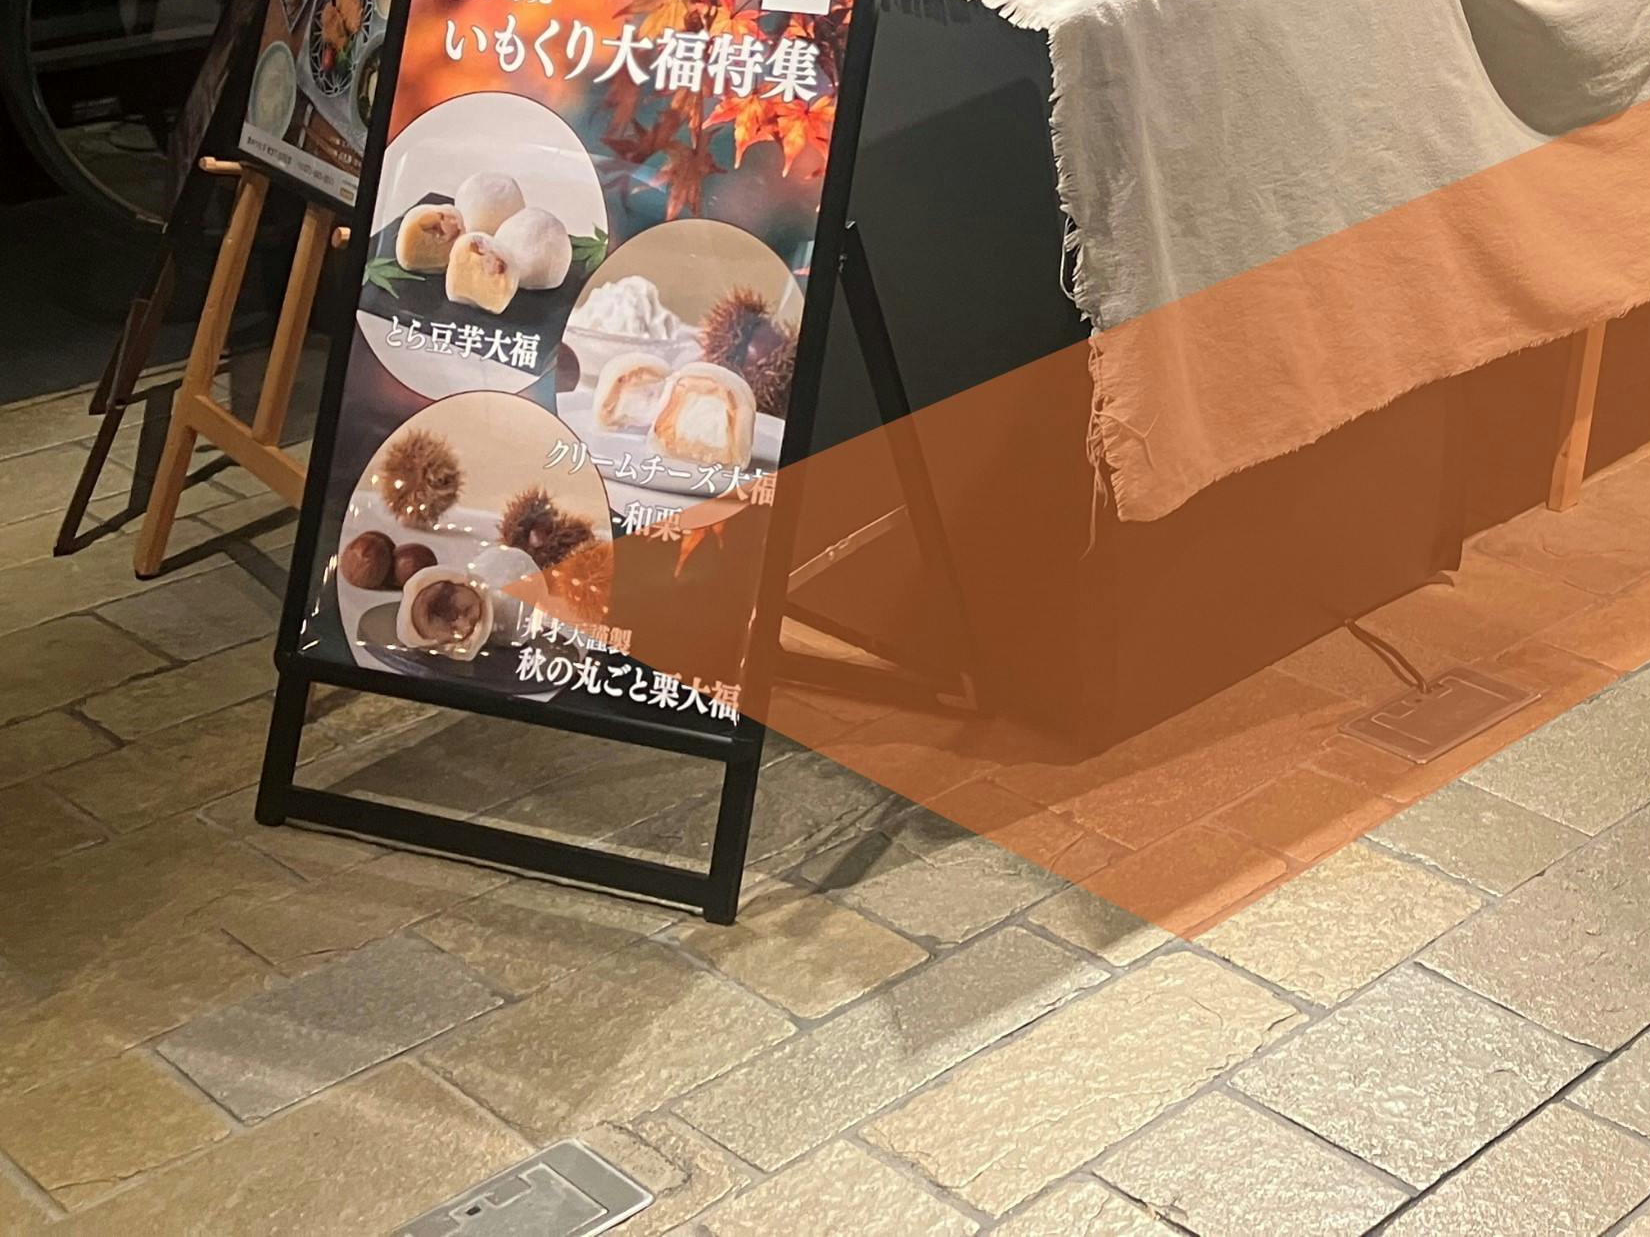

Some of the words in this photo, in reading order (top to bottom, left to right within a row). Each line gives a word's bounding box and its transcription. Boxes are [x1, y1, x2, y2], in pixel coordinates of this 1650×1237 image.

[443, 14, 821, 103] いもくり大福特集
[385, 315, 542, 369] とら豆芋大福
[543, 439, 778, 508] クリームチーズ大福
[514, 645, 743, 724] 秋の丸ごと栗大福
